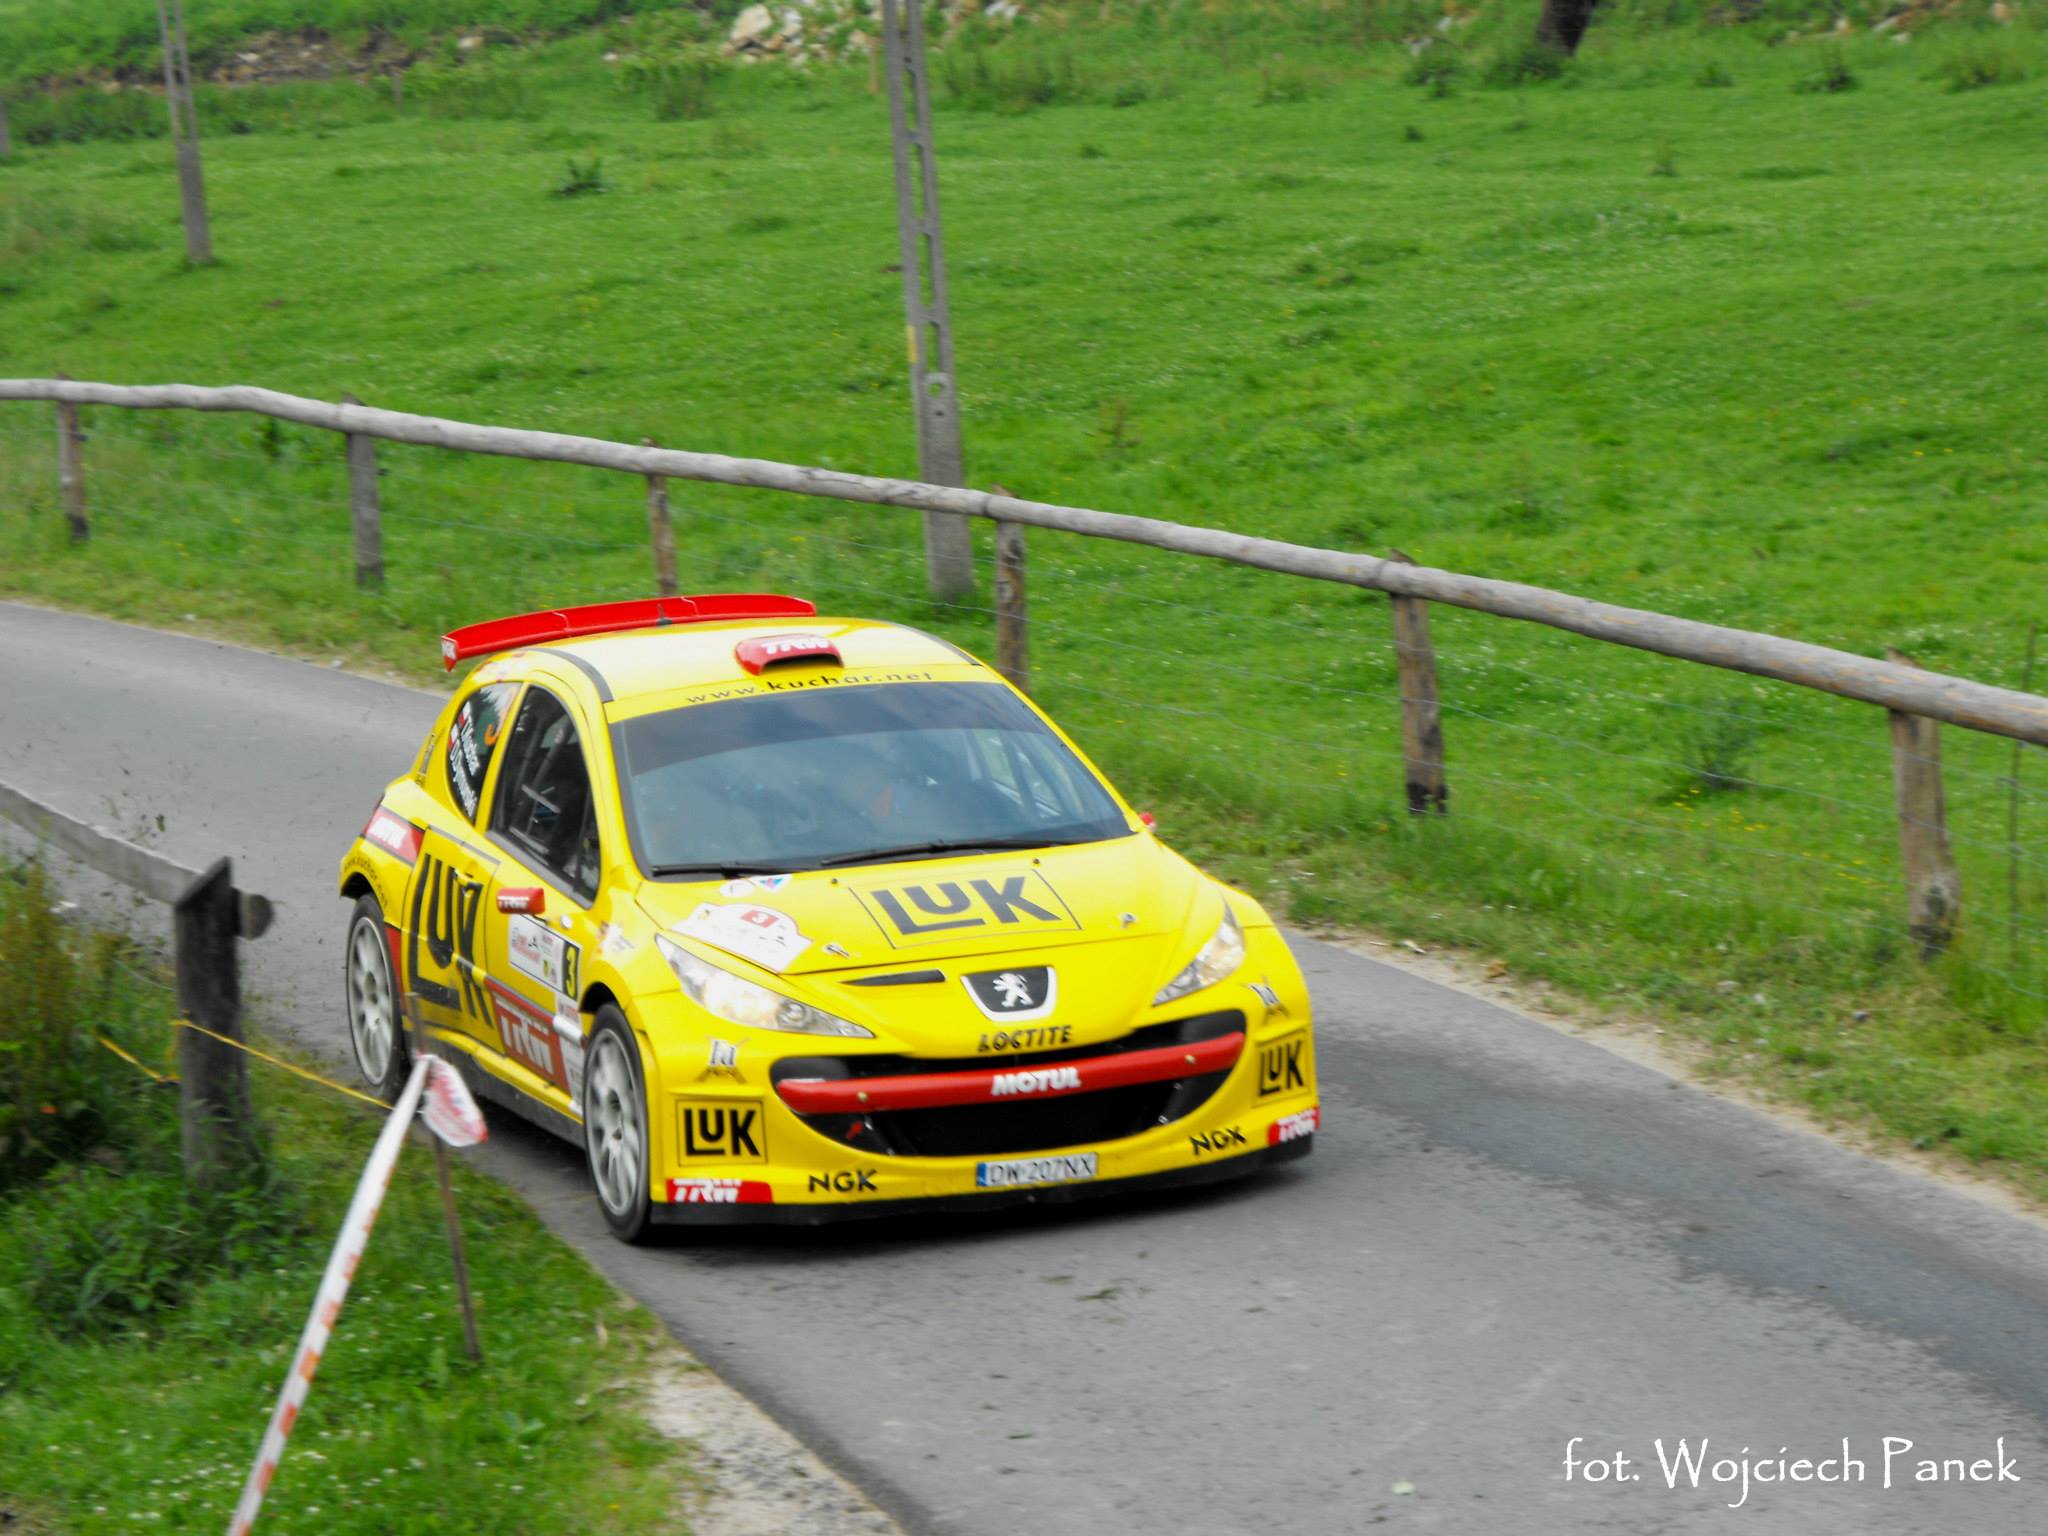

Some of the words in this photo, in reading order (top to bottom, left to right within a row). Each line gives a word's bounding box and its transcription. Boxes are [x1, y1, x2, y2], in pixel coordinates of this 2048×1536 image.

[760, 638, 830, 654] TRW
[686, 671, 934, 704] www.kuchar.net
[566, 945, 577, 999] 3
[978, 1025, 1073, 1051] LOCTITE
[991, 1066, 1082, 1096] MOTUL
[1279, 1108, 1318, 1142] TRW
[1189, 1126, 1247, 1156] NGK
[673, 1178, 742, 1203] TRW
[808, 1169, 878, 1193] NGK
